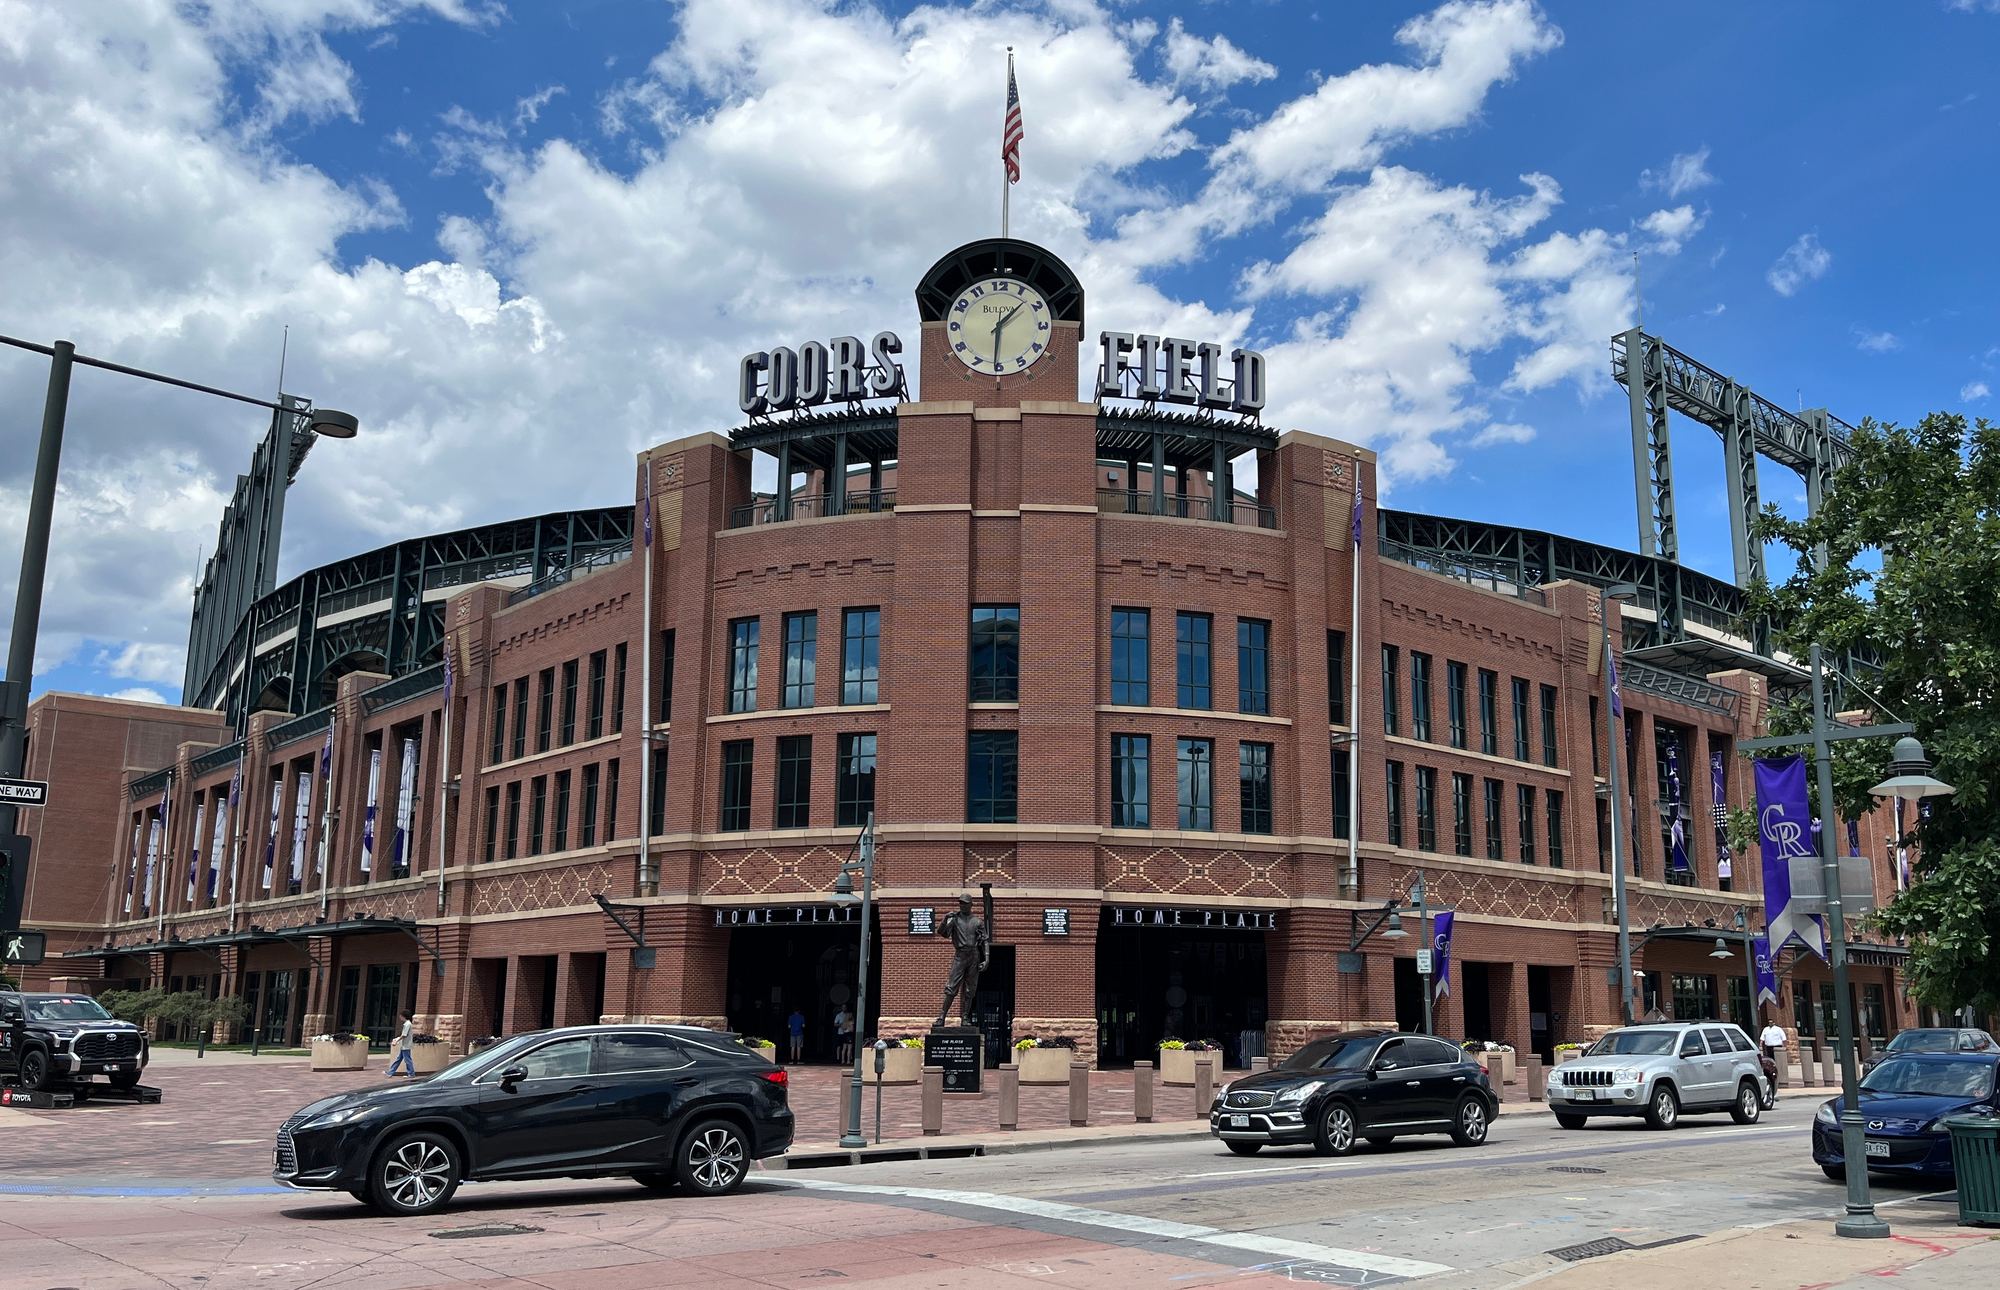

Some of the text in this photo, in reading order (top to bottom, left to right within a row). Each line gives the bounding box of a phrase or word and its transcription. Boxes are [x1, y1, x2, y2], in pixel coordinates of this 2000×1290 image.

[970, 285, 985, 298] 11
[991, 281, 1009, 292] 12
[1018, 285, 1027, 296] 1
[954, 298, 969, 313] 10
[983, 305, 1016, 314] BULOVA
[1031, 300, 1043, 312] 2
[950, 321, 961, 332] 9
[1038, 321, 1049, 331] 3
[955, 341, 967, 353] 8
[1031, 342, 1043, 353] 4
[971, 356, 984, 366] 7
[1015, 356, 1027, 367] 5
[994, 362, 1004, 372] 6
[739, 331, 1265, 416] COORS FIELD
[0, 786, 39, 798] NE WAY
[716, 907, 852, 925] HOME PLAT
[1115, 909, 1275, 928] HOME PLATE
[11, 1093, 32, 1102] TOYOTA
